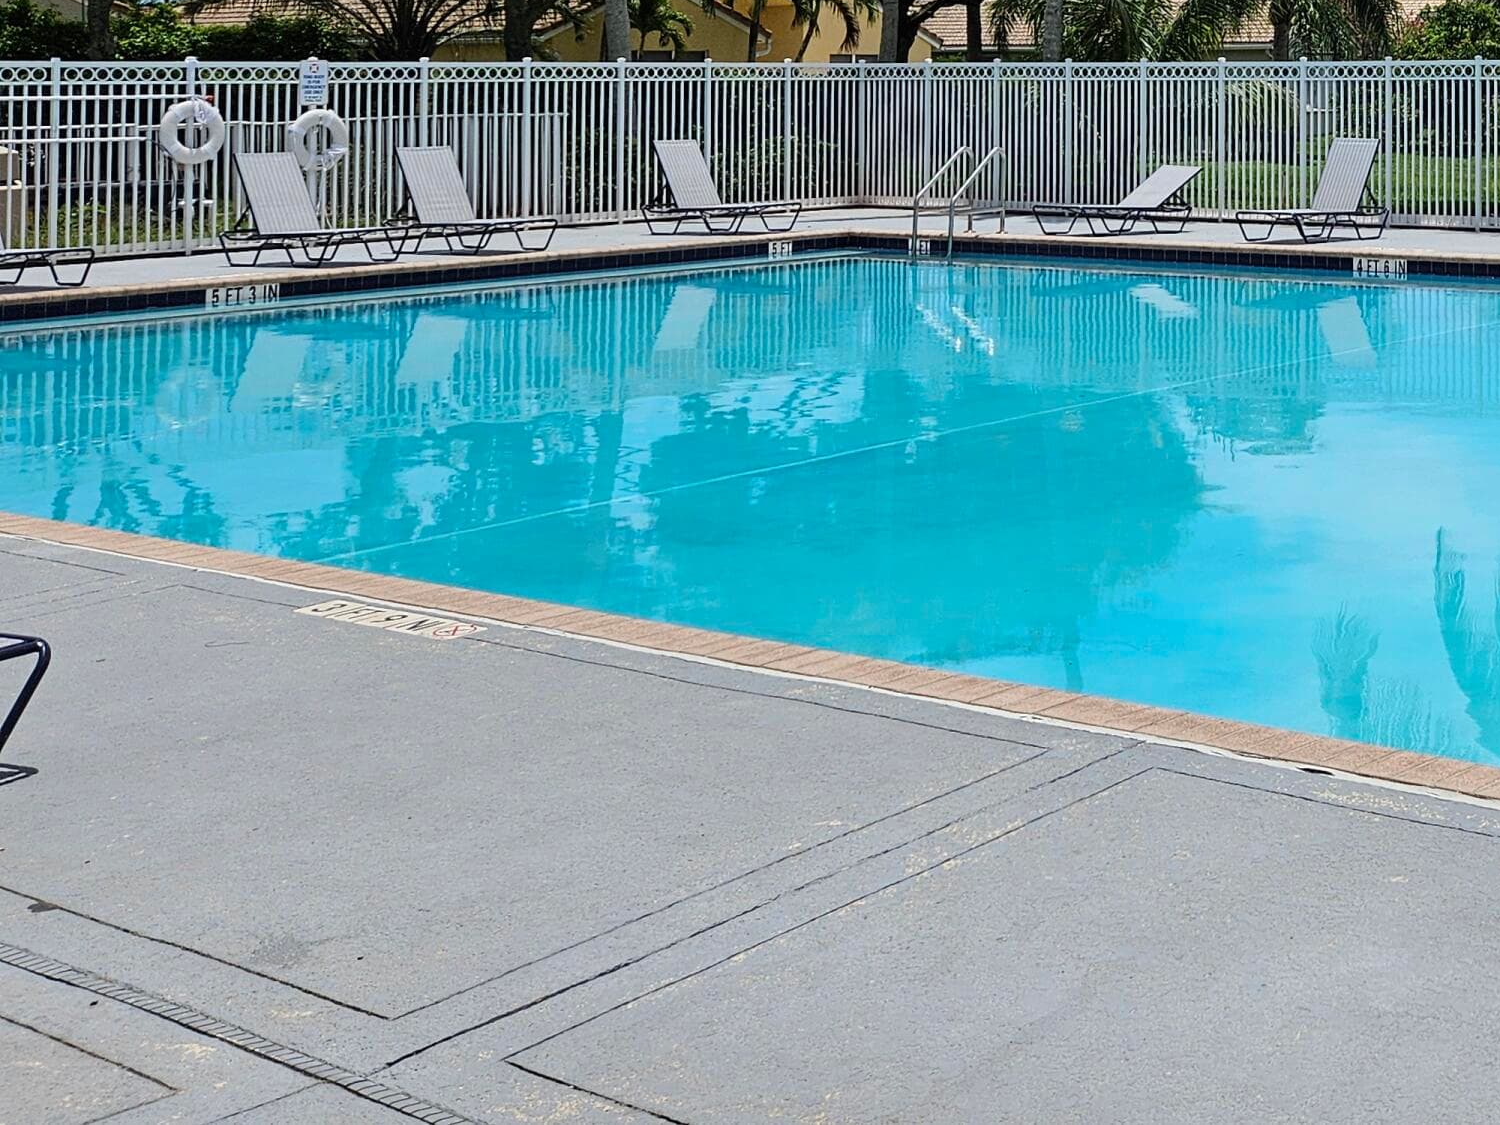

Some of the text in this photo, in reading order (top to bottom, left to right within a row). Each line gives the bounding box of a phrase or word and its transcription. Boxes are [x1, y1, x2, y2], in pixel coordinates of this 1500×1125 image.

[772, 242, 792, 255] 5 FT
[1357, 258, 1363, 272] 4
[1367, 259, 1380, 273] FT
[1395, 260, 1406, 274] IN
[212, 284, 278, 304] 5 FT 3 IN
[311, 603, 347, 612] 3
[333, 608, 386, 619] FT
[395, 618, 446, 631] IN
